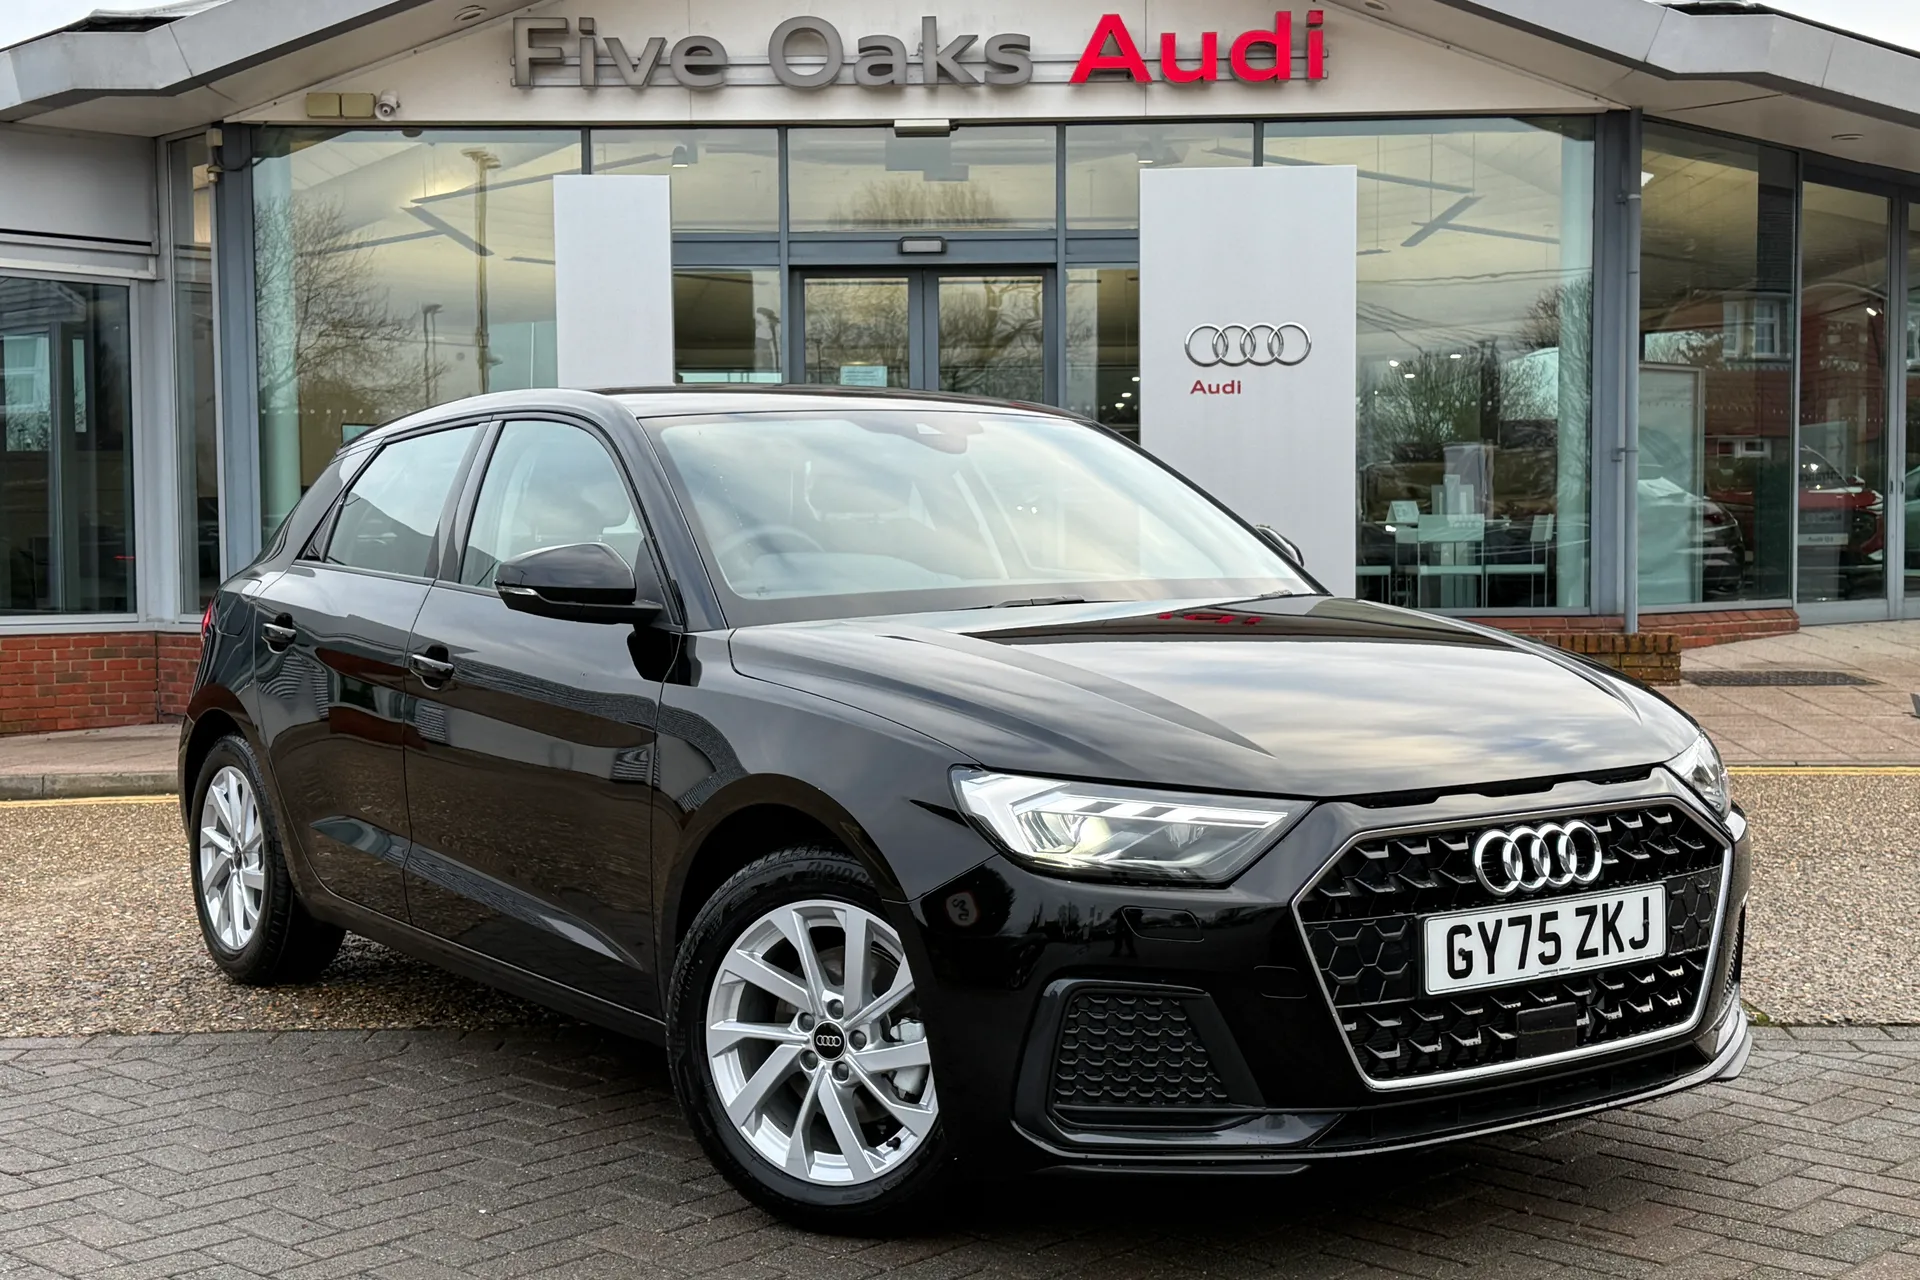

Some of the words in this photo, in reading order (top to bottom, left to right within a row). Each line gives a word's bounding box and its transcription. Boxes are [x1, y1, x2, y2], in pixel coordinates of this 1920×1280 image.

[513, 17, 729, 88] Five
[768, 16, 1031, 88] Oaks
[1069, 9, 1324, 85] Audi
[1190, 379, 1242, 395] Audi
[1446, 911, 1562, 980] GY75
[1575, 896, 1650, 960] ZKJ
